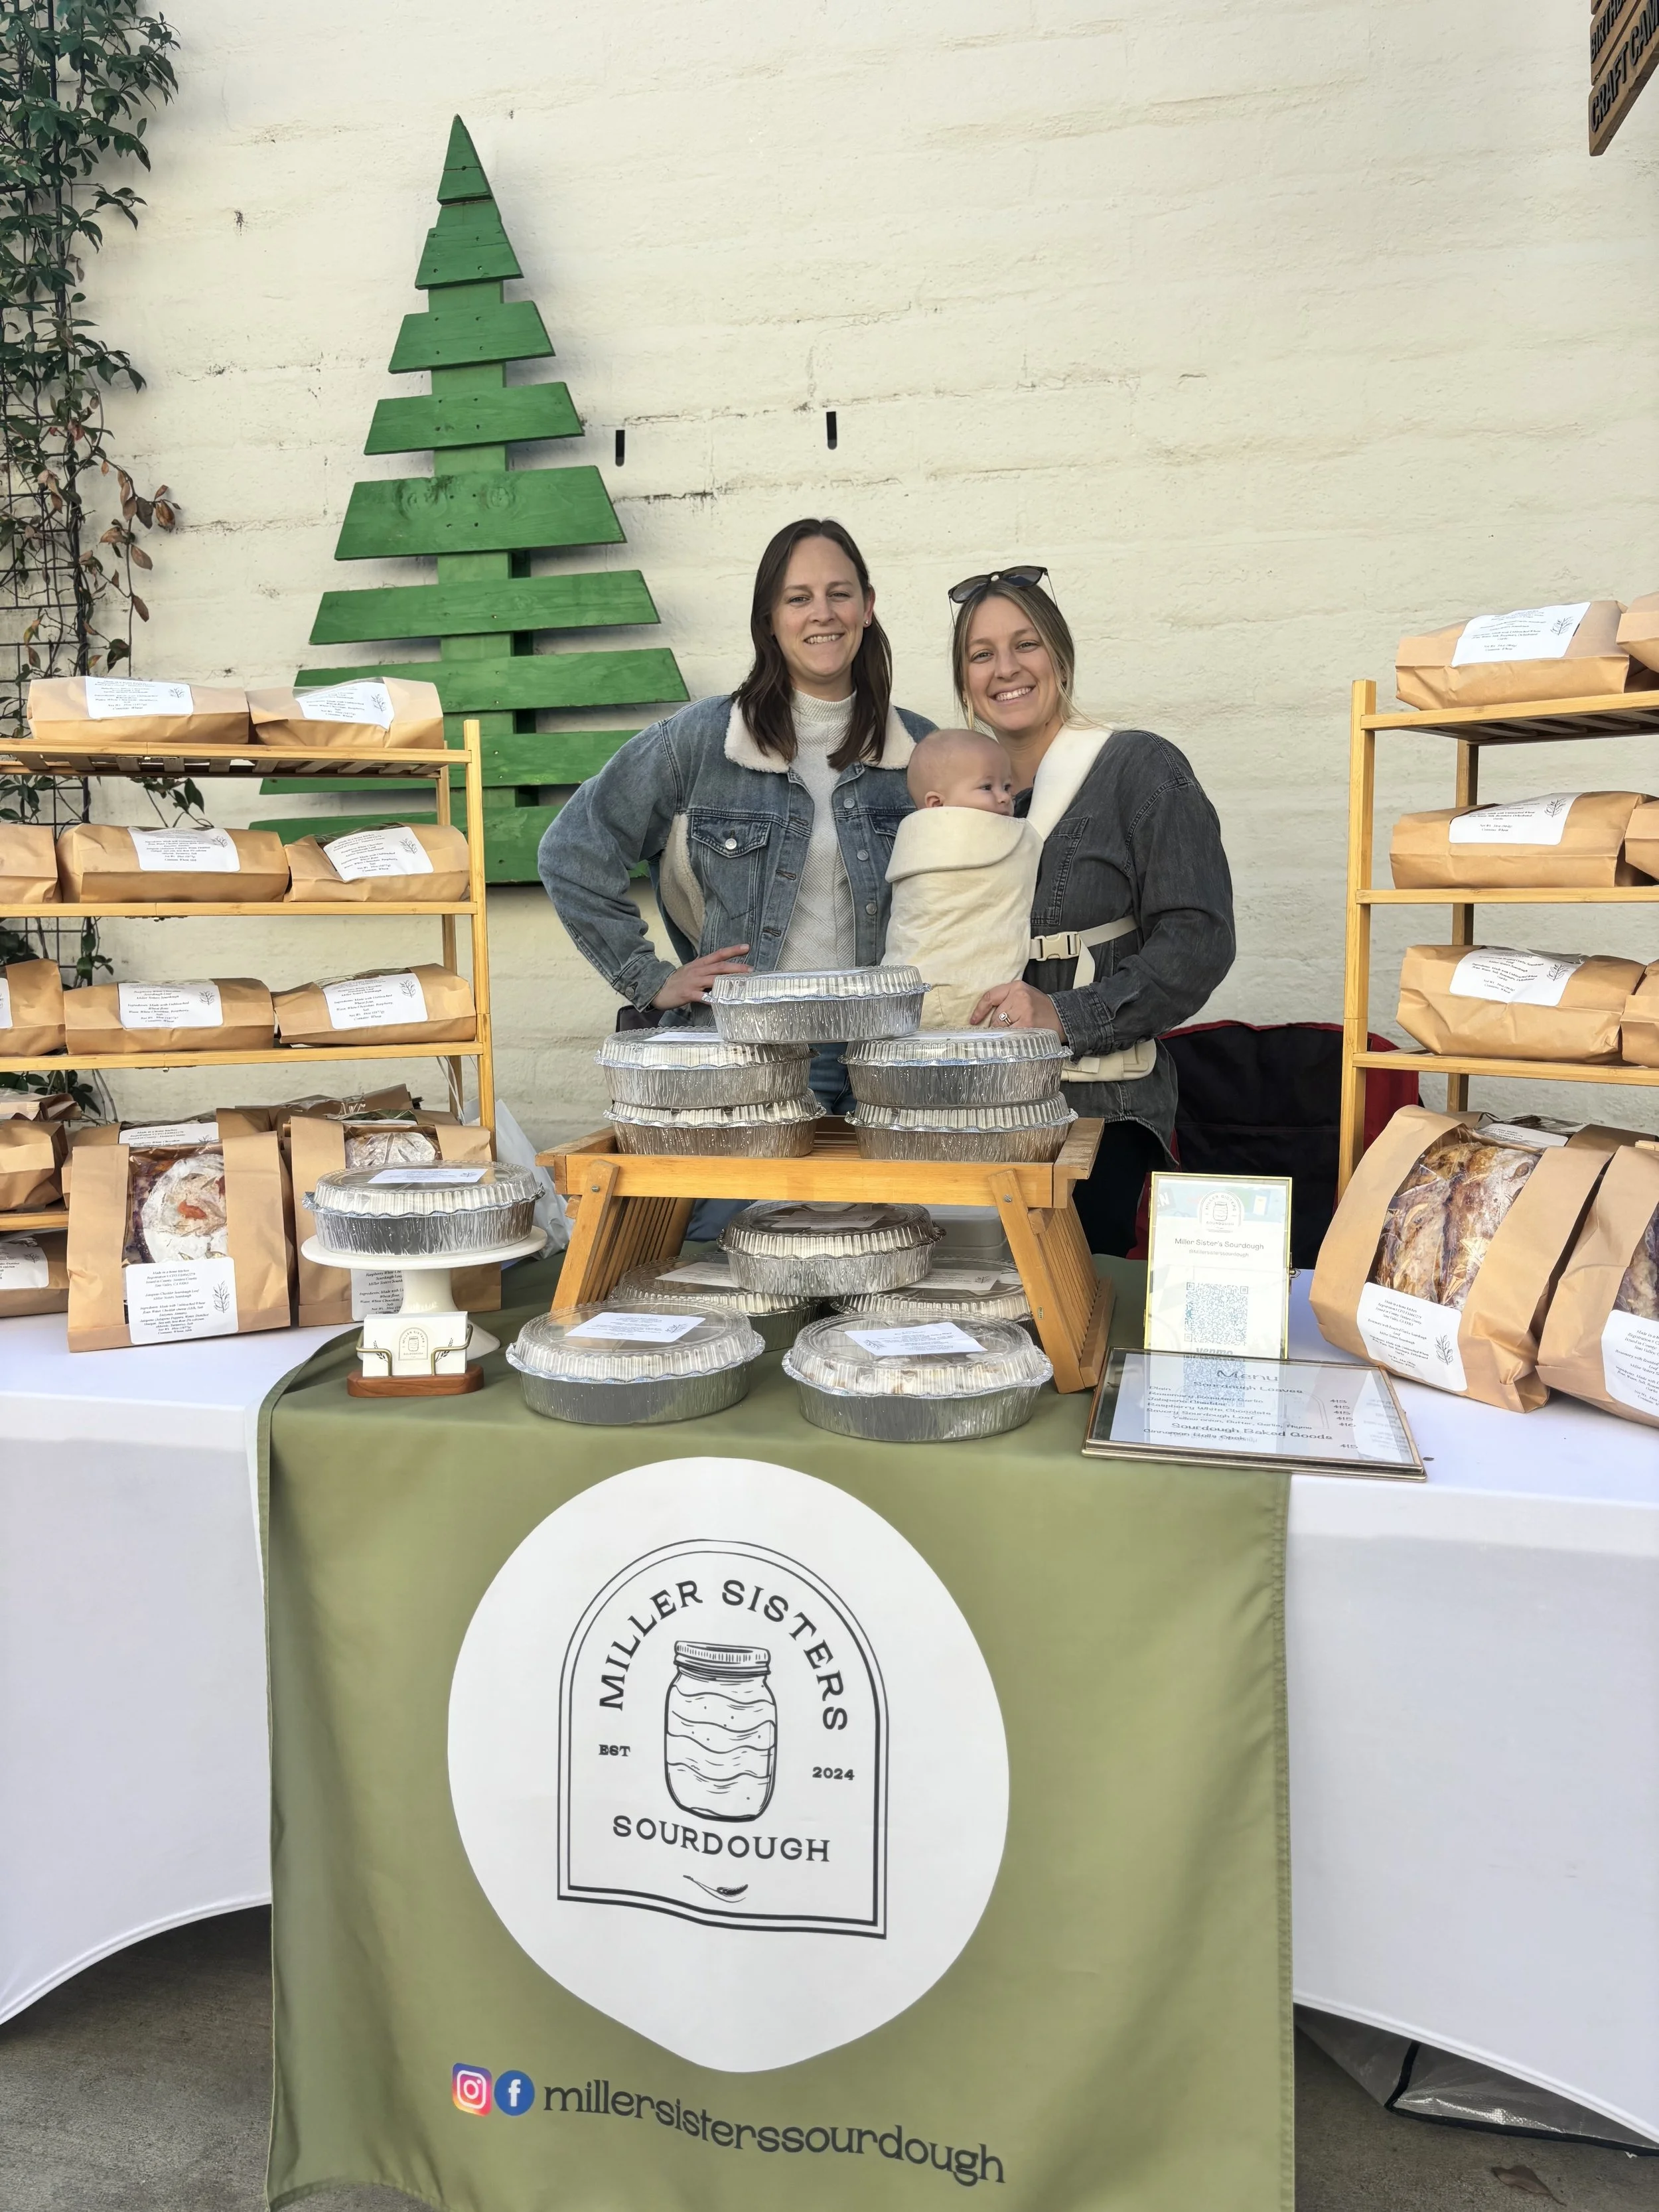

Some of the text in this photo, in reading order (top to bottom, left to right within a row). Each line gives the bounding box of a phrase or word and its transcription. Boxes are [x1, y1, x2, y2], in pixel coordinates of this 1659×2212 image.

[1591, 0, 1626, 64] BIRTHD
[1591, 41, 1628, 133] CRAFT
[1224, 1242, 1264, 1251] Sourdough
[1217, 1370, 1278, 1381] Menu
[1193, 1382, 1256, 1391] Sourdough
[1171, 1423, 1240, 1434] Sourdough
[599, 1579, 848, 1731] MILLER SISTERS
[599, 1744, 630, 1758] EST
[812, 1766, 855, 1781] 2024
[613, 1814, 831, 1862] SOURDOUGH
[543, 2079, 1006, 2187] millersisterssourdough
